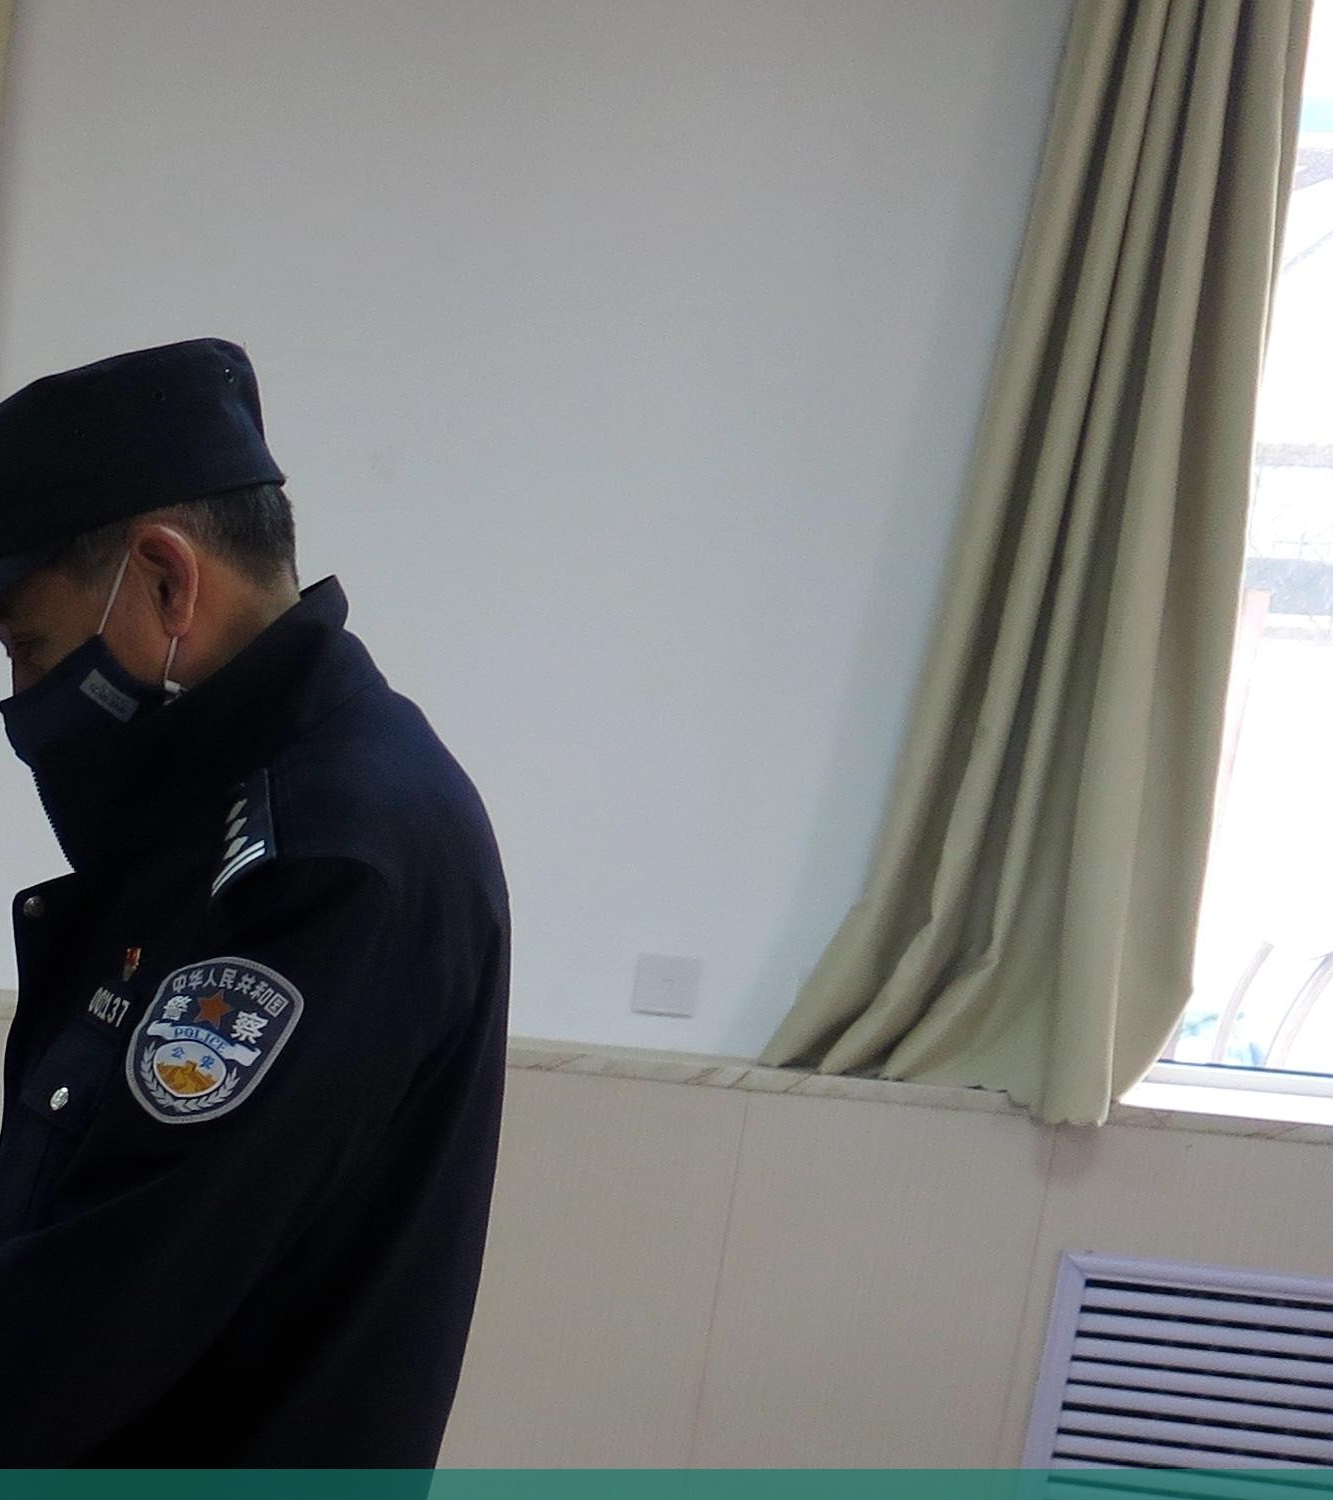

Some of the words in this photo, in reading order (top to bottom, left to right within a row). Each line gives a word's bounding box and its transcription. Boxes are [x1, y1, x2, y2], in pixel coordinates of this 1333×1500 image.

[173, 967, 289, 1018] 中华人民共和国
[174, 1026, 227, 1055] POLICE
